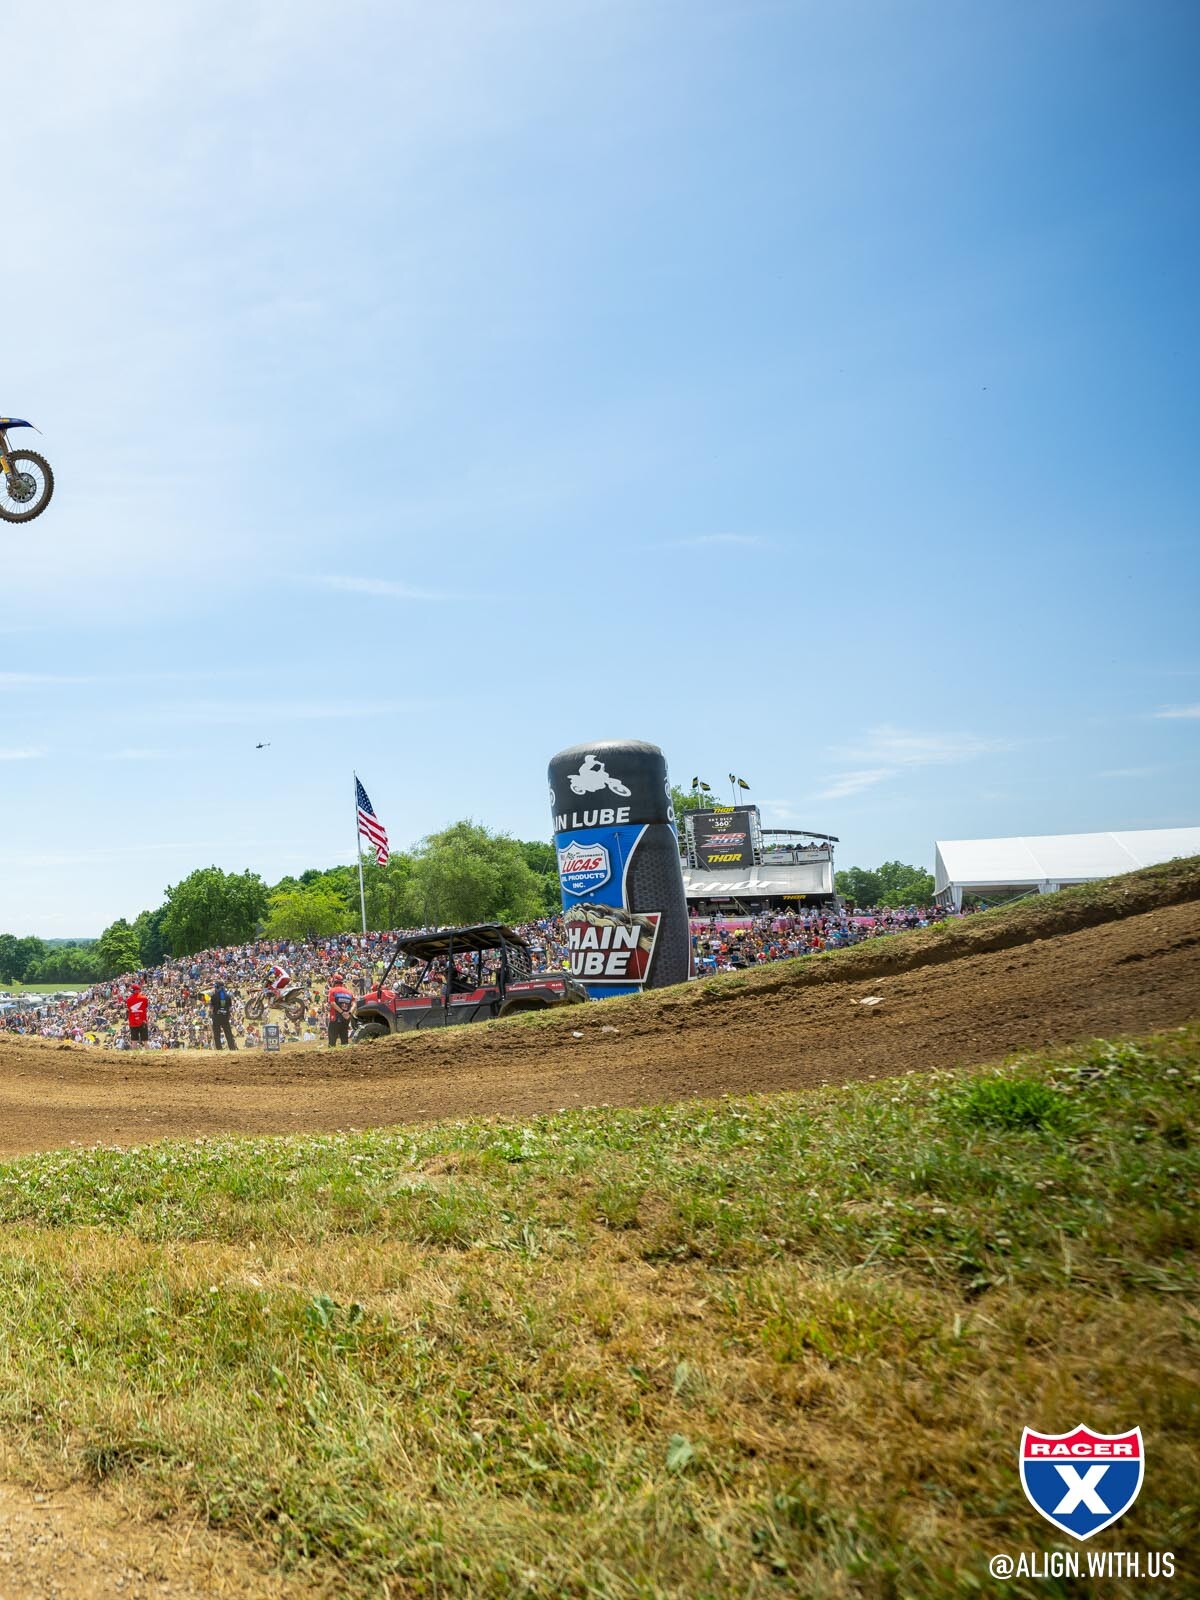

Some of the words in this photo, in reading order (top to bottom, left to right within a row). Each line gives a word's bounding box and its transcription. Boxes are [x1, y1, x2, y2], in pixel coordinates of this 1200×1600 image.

[572, 806, 631, 828] LUBE
[562, 857, 603, 873] LUCAS
[707, 853, 743, 863] THOR
[569, 873, 605, 881] PRODUCTS
[568, 925, 641, 949] HAIN
[571, 951, 631, 975] UBE
